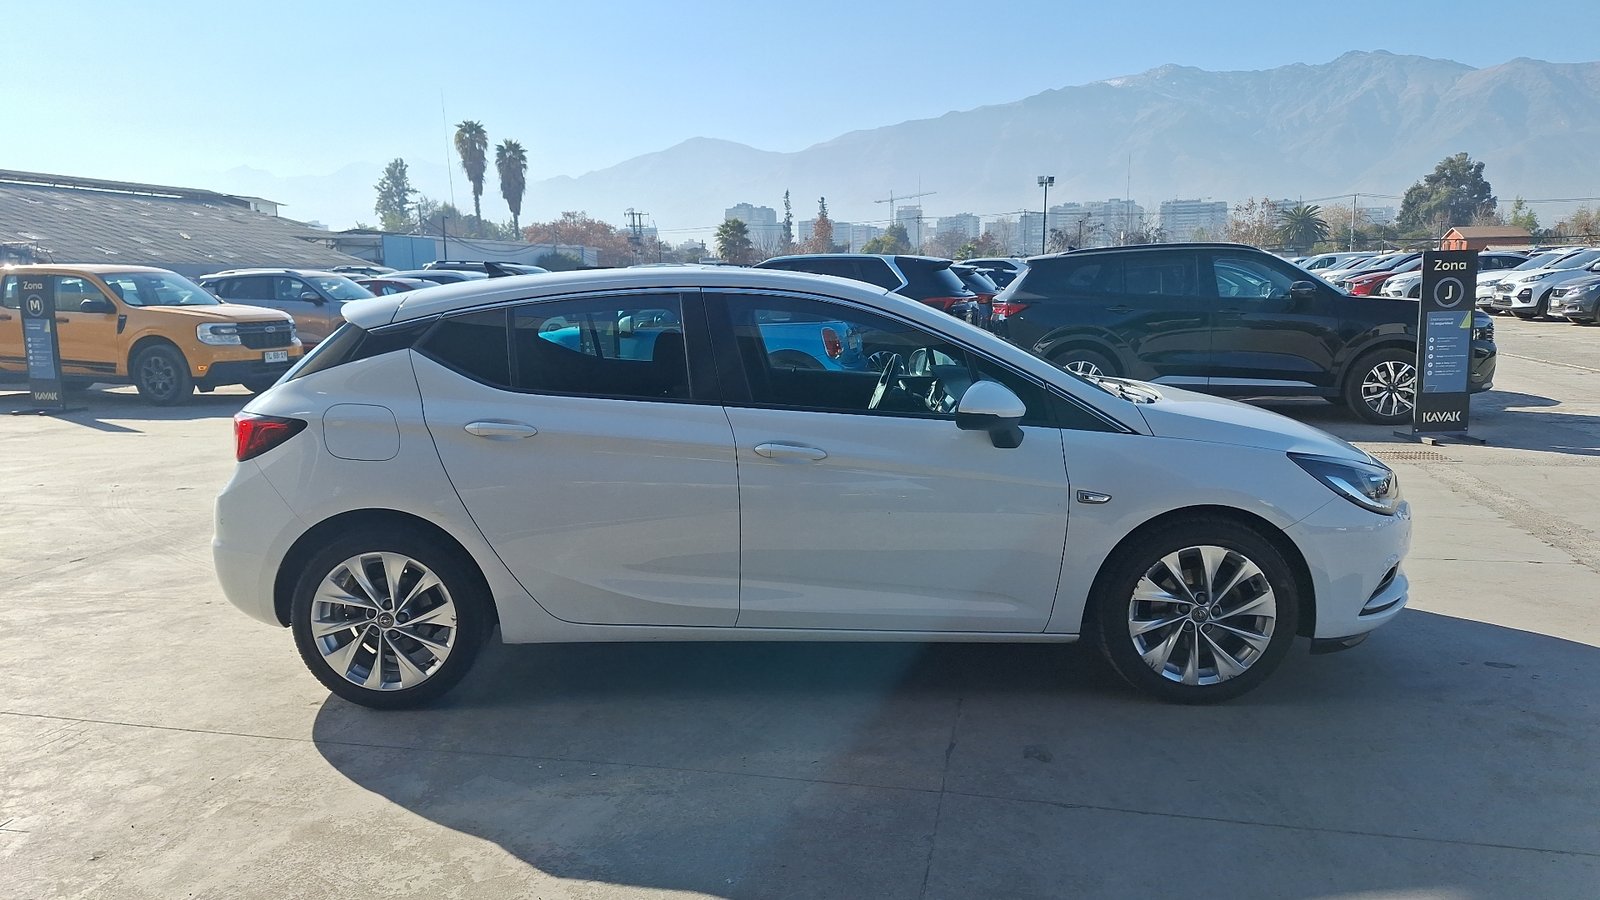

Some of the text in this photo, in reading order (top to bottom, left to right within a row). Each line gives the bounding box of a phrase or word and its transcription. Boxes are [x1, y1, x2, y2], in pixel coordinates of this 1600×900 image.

[1434, 260, 1467, 271] Zona
[23, 281, 43, 290] Zona
[1445, 285, 1453, 299] J
[30, 300, 40, 311] M
[34, 392, 58, 400] KAVAK
[1423, 411, 1461, 423] KAVAK
